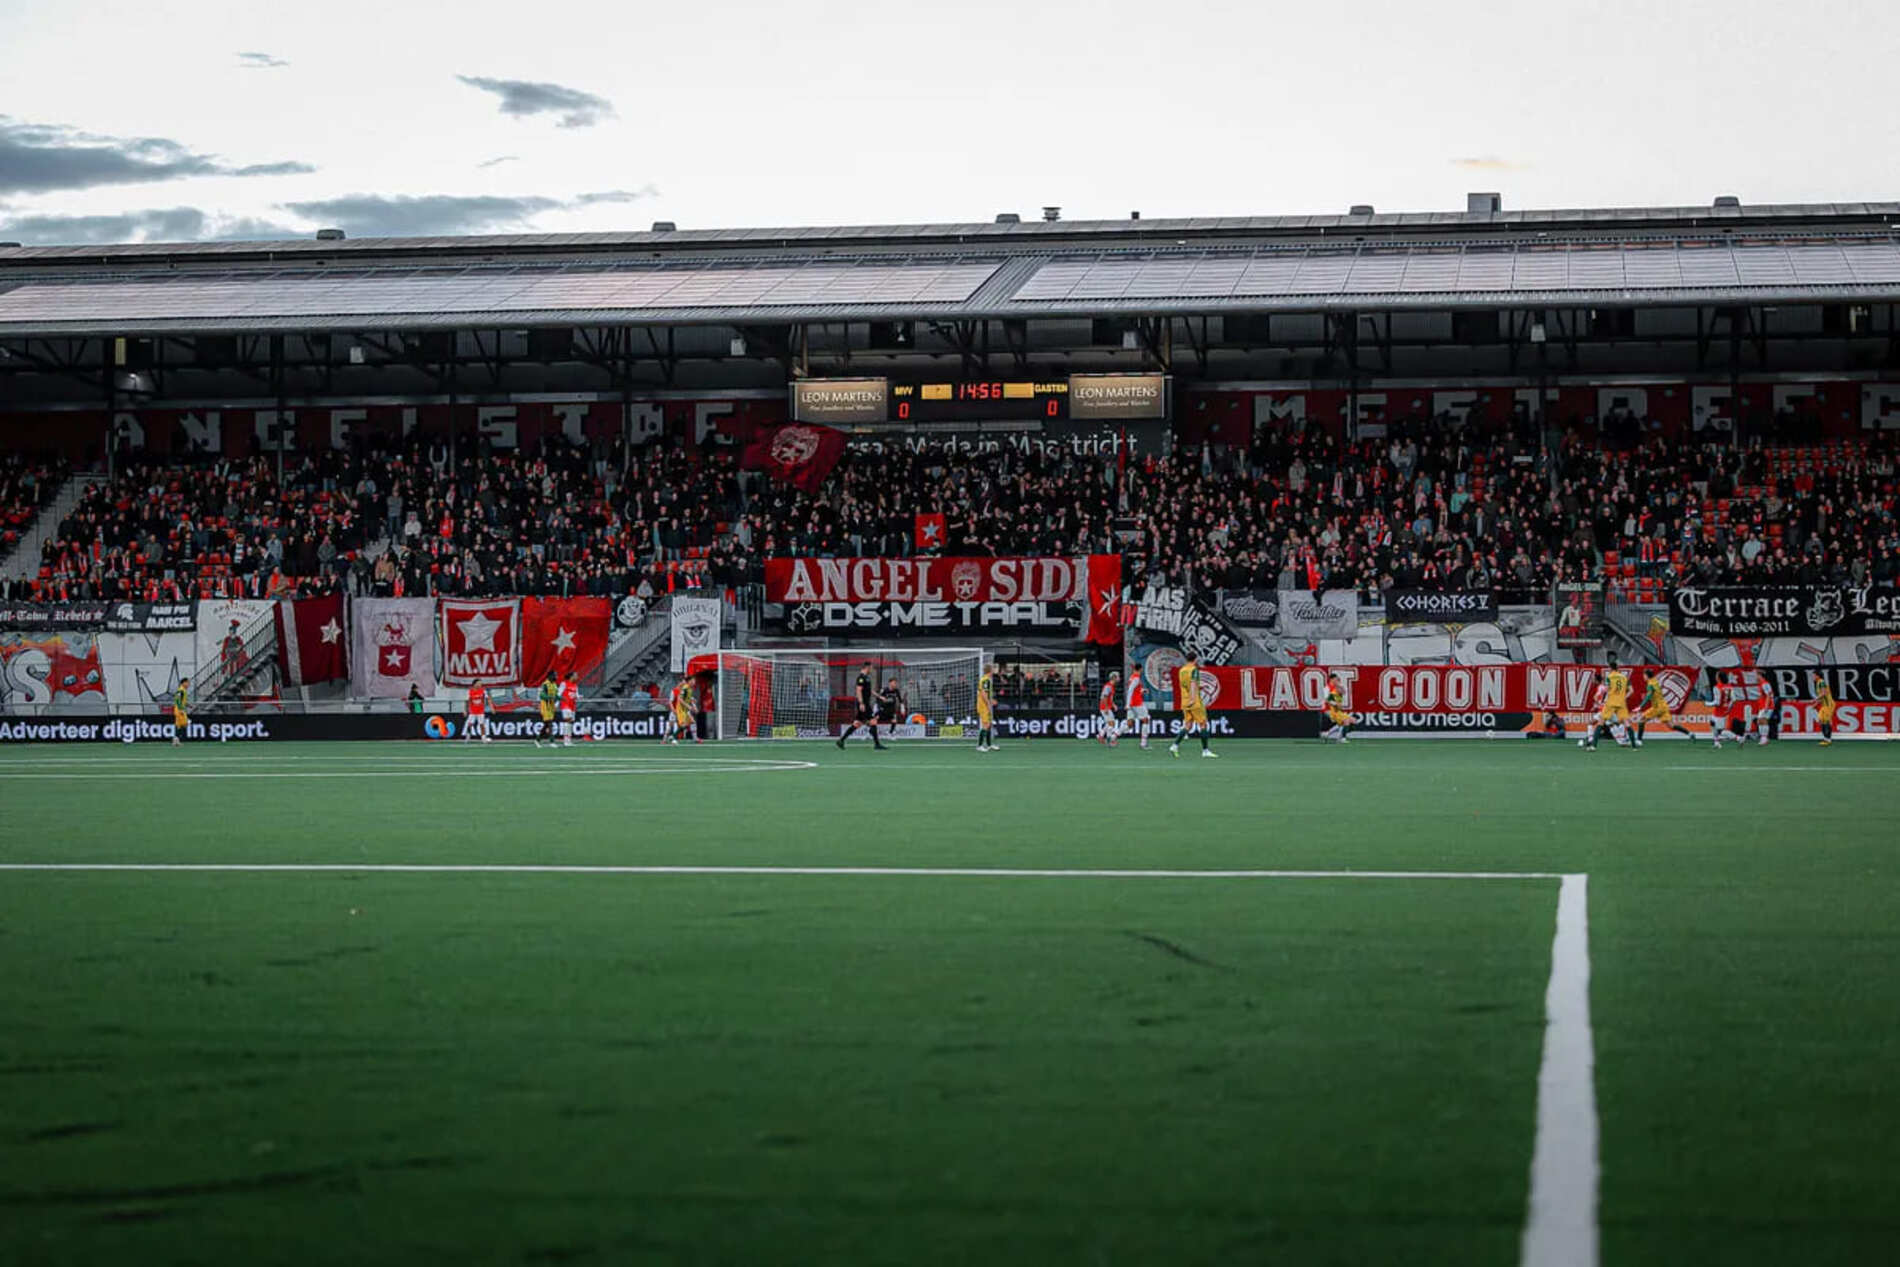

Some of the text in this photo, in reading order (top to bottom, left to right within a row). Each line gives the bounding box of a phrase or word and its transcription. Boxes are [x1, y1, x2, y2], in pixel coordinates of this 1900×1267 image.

[801, 390, 883, 403] LEON MARTENS
[959, 383, 1001, 399] 14:56
[1034, 383, 1069, 394] GASTEN
[1074, 387, 1158, 399] LEON MARTENS
[898, 402, 910, 419] 0
[1046, 400, 1059, 417] 0
[784, 559, 942, 601] ANGEL
[1395, 595, 1475, 609] COHORTES
[1673, 587, 1799, 617] Terrace
[1240, 667, 1358, 711] LAOT
[1378, 666, 1506, 711] GOON
[187, 719, 205, 738] in
[209, 719, 269, 741] sport.
